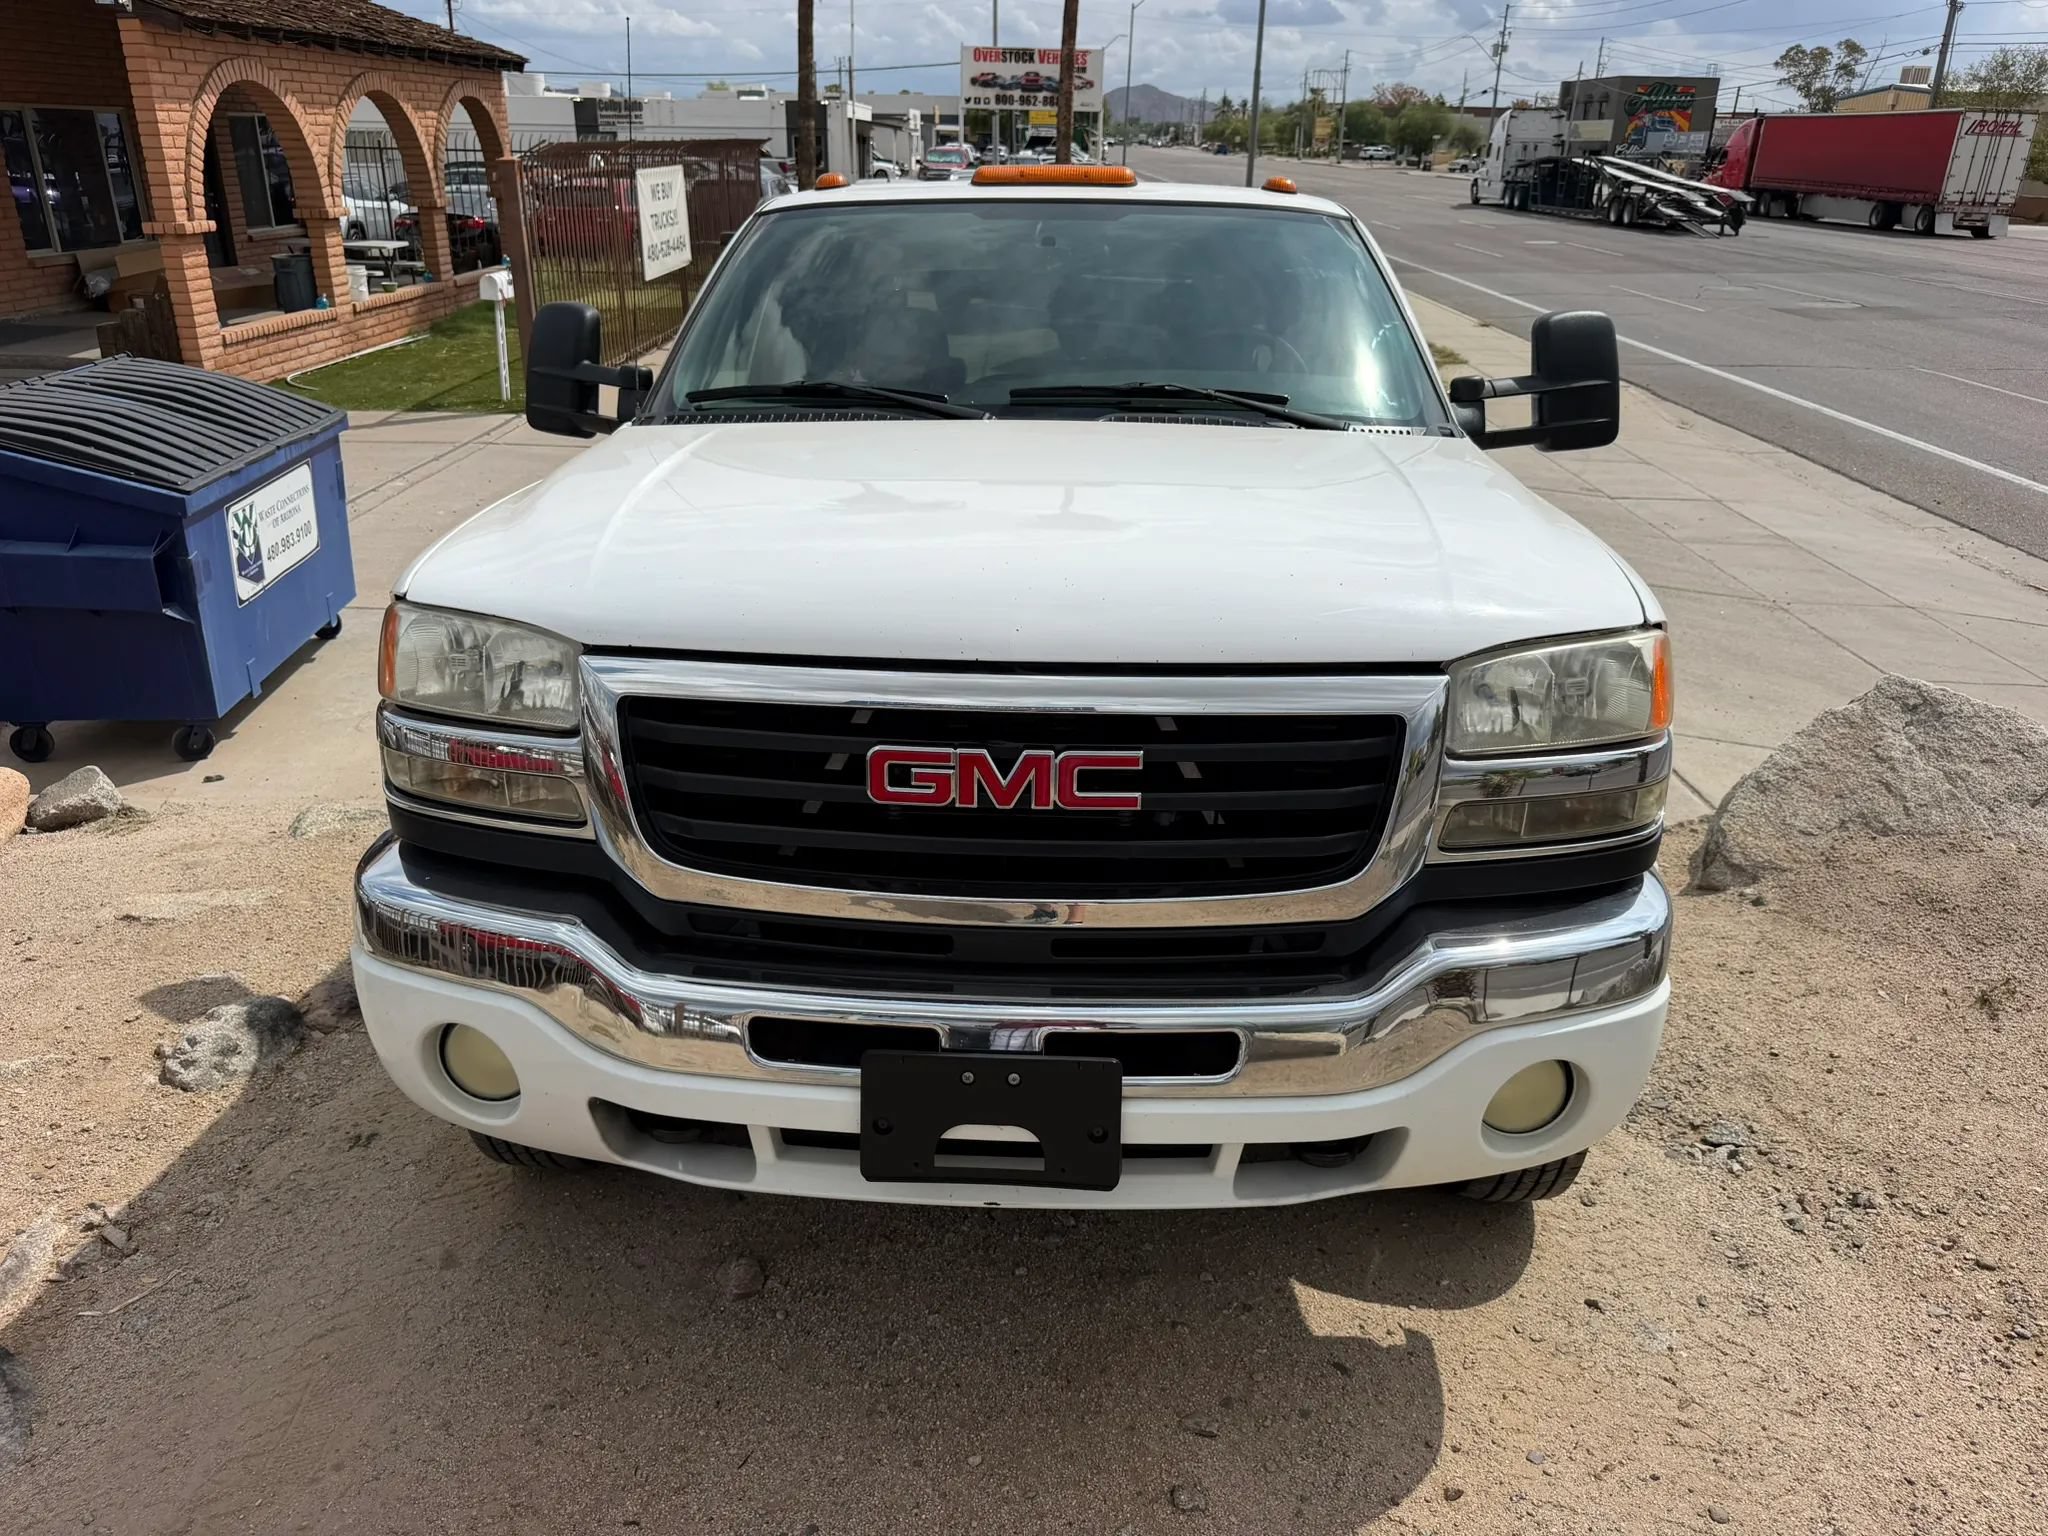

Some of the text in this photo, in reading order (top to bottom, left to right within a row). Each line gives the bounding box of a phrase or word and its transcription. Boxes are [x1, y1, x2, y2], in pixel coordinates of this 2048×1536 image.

[973, 47, 1035, 64] OVERSTOCK
[650, 180, 673, 202] WE BUY
[258, 484, 310, 522] WASTE CONNECTIONS
[267, 520, 313, 563] 480.983.9100
[866, 745, 1144, 811] GMC
